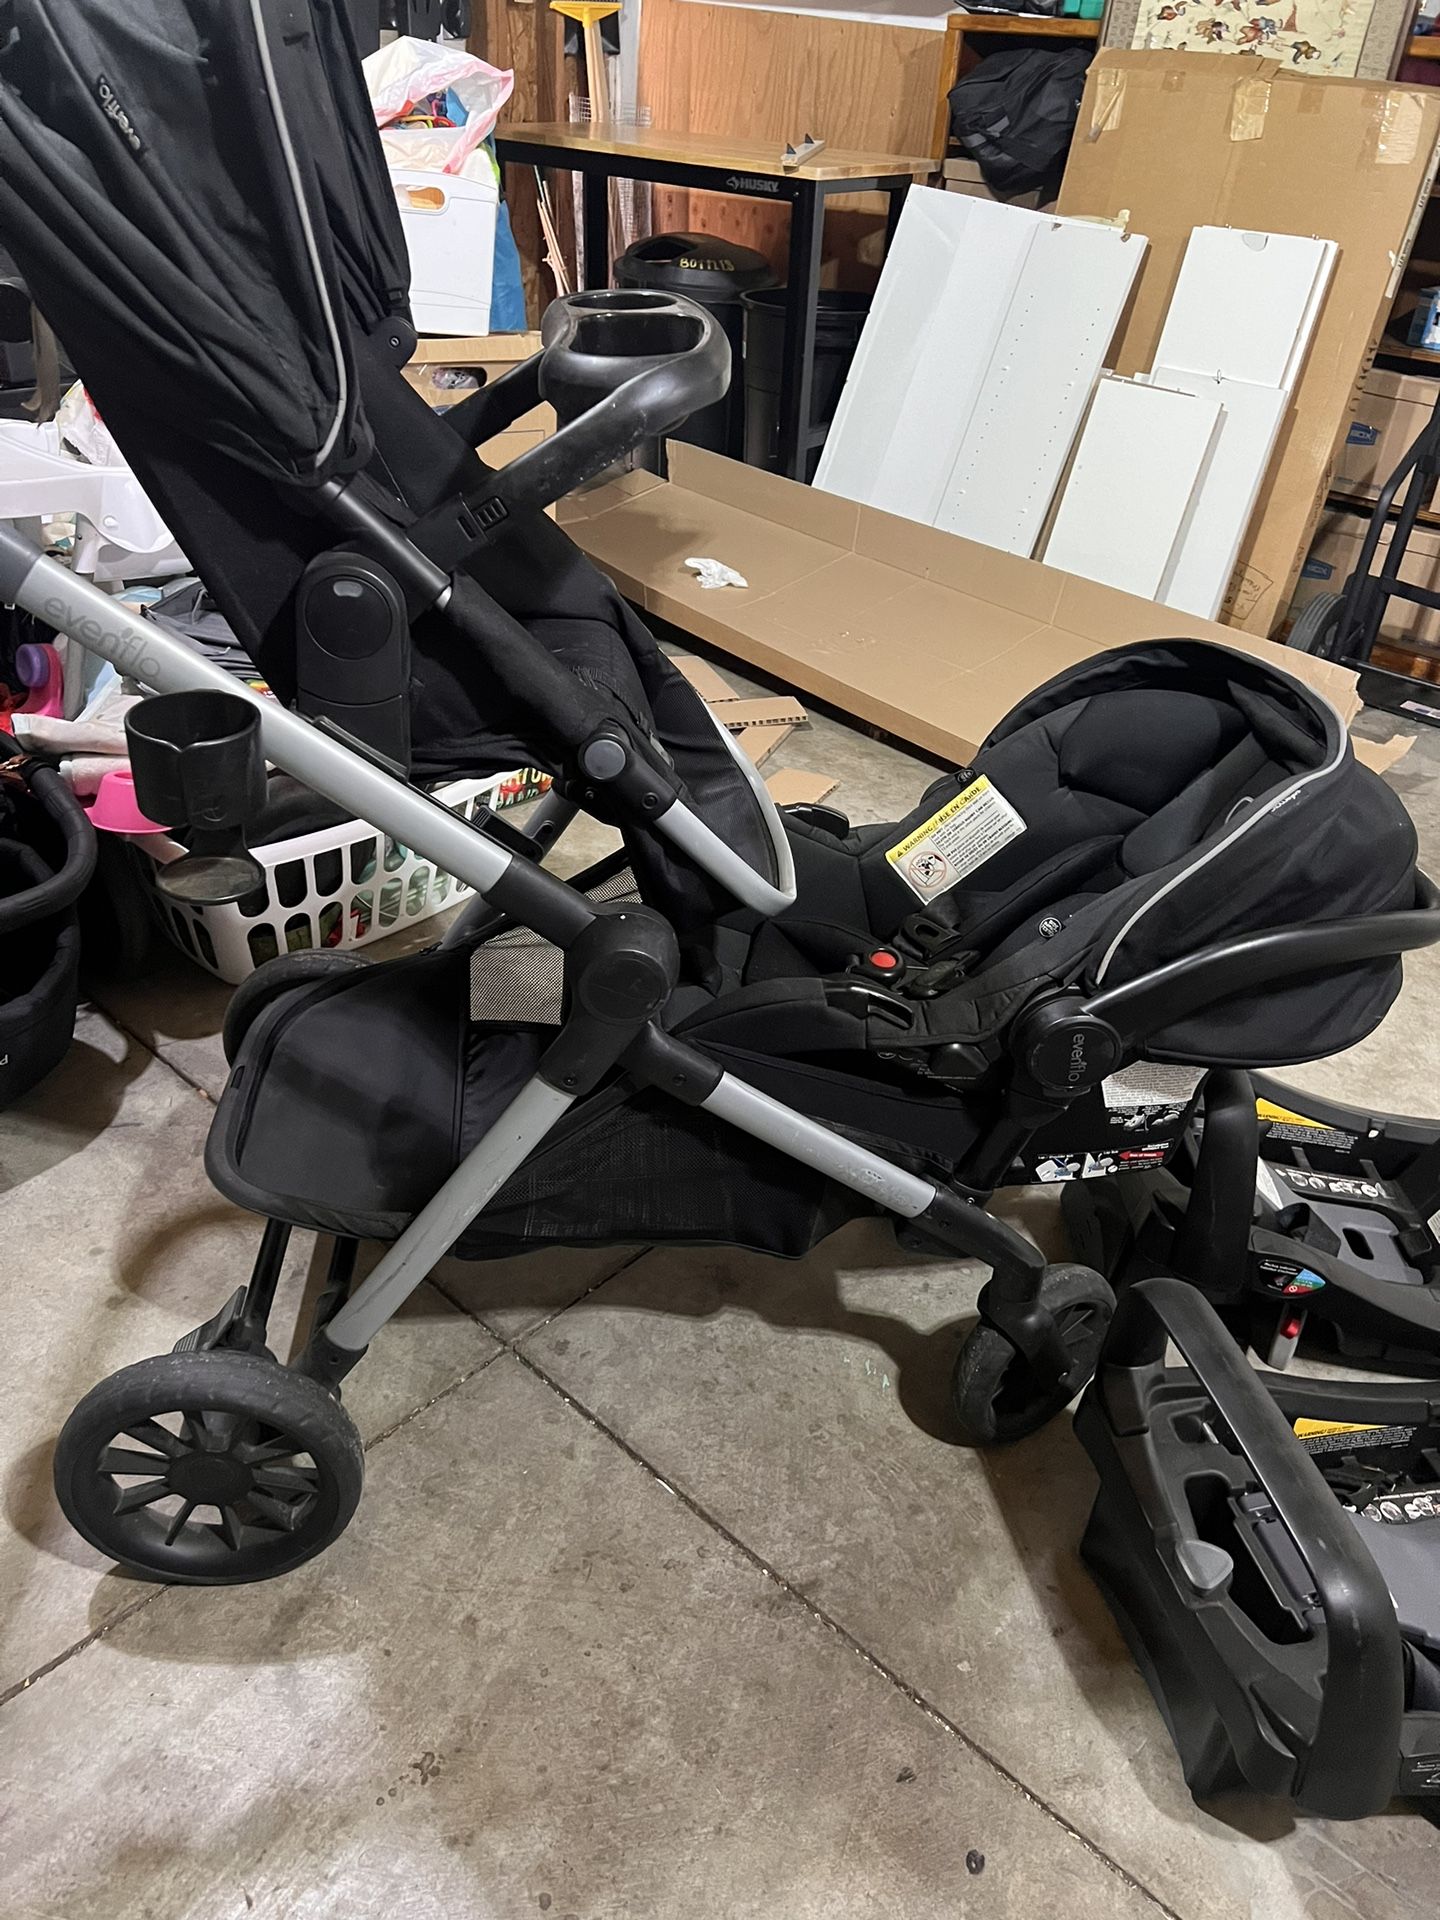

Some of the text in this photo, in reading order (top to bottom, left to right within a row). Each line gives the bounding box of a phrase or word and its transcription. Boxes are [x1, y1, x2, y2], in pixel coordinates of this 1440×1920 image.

[740, 177, 780, 193] HUSKY
[44, 597, 161, 678] evenflo
[1068, 1033, 1088, 1082] evenflo
